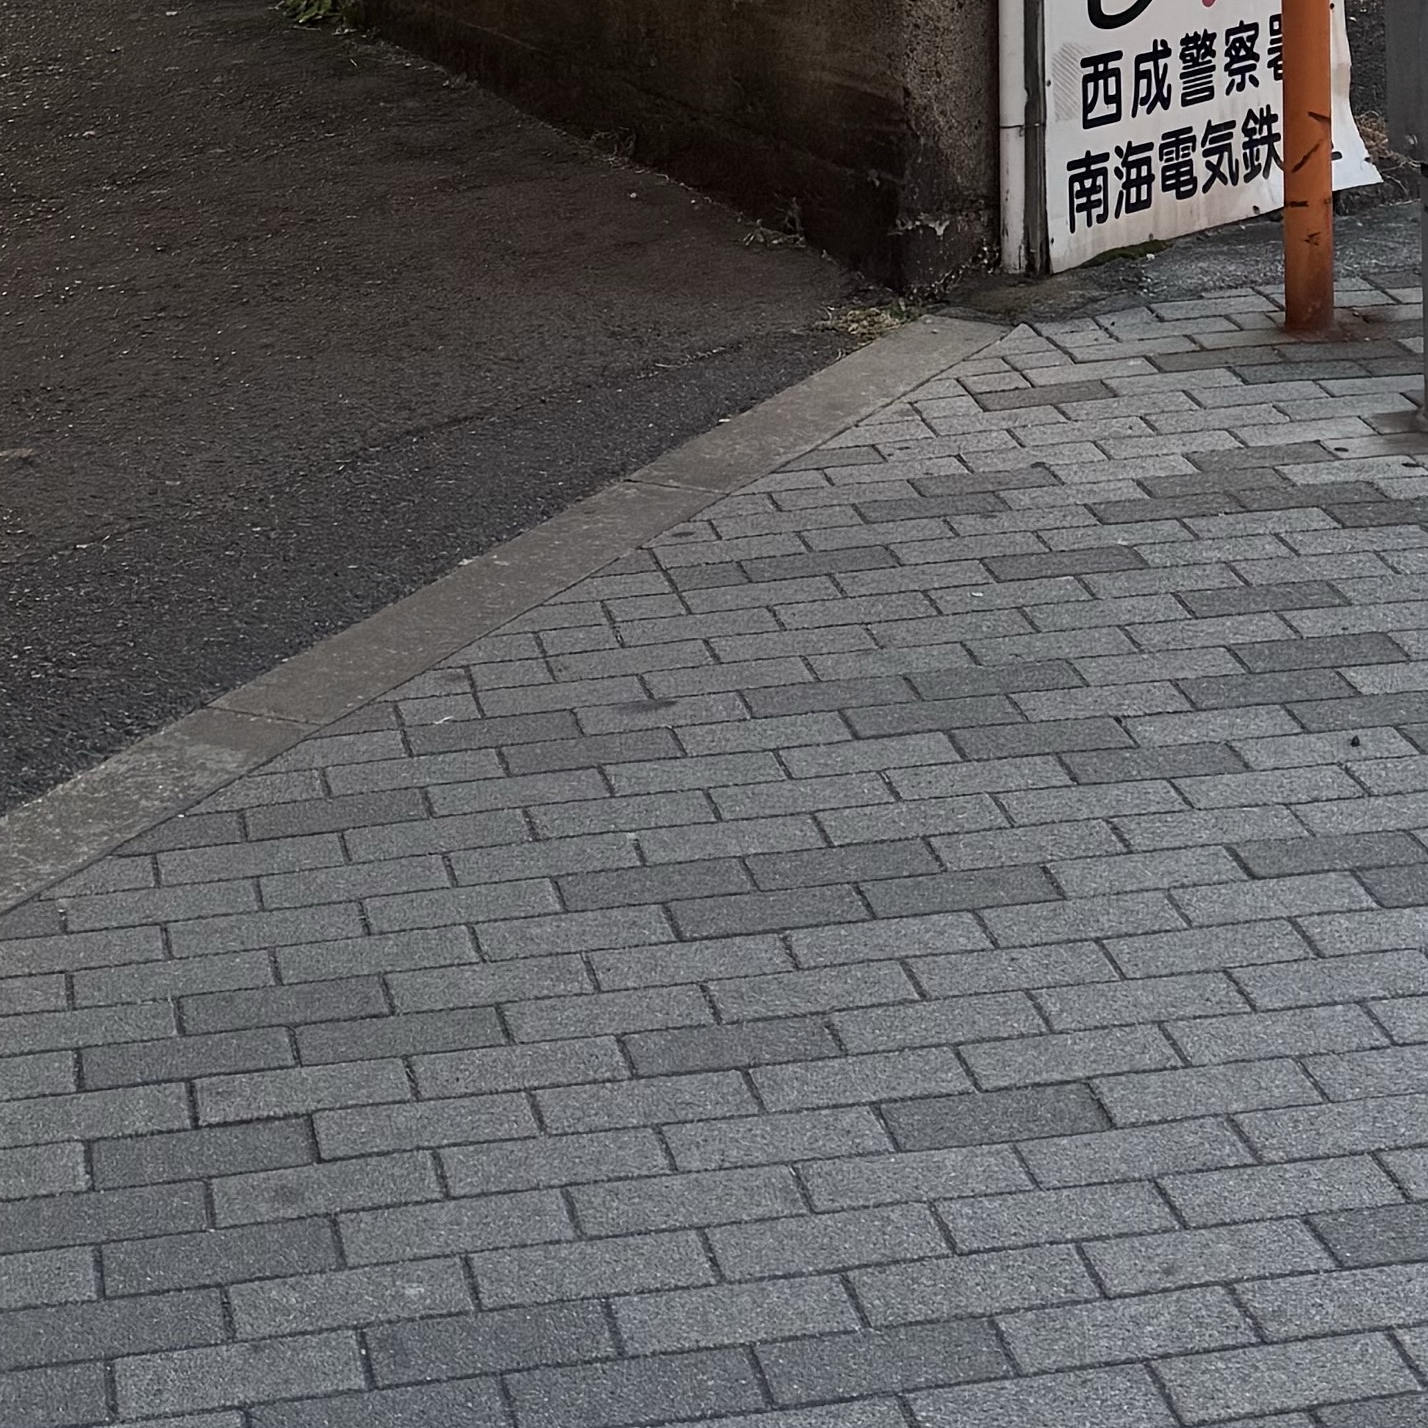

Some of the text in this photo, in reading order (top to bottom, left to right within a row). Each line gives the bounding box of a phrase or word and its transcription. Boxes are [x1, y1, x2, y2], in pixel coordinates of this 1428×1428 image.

[1066, 104, 1343, 234] 南海電気鉄
